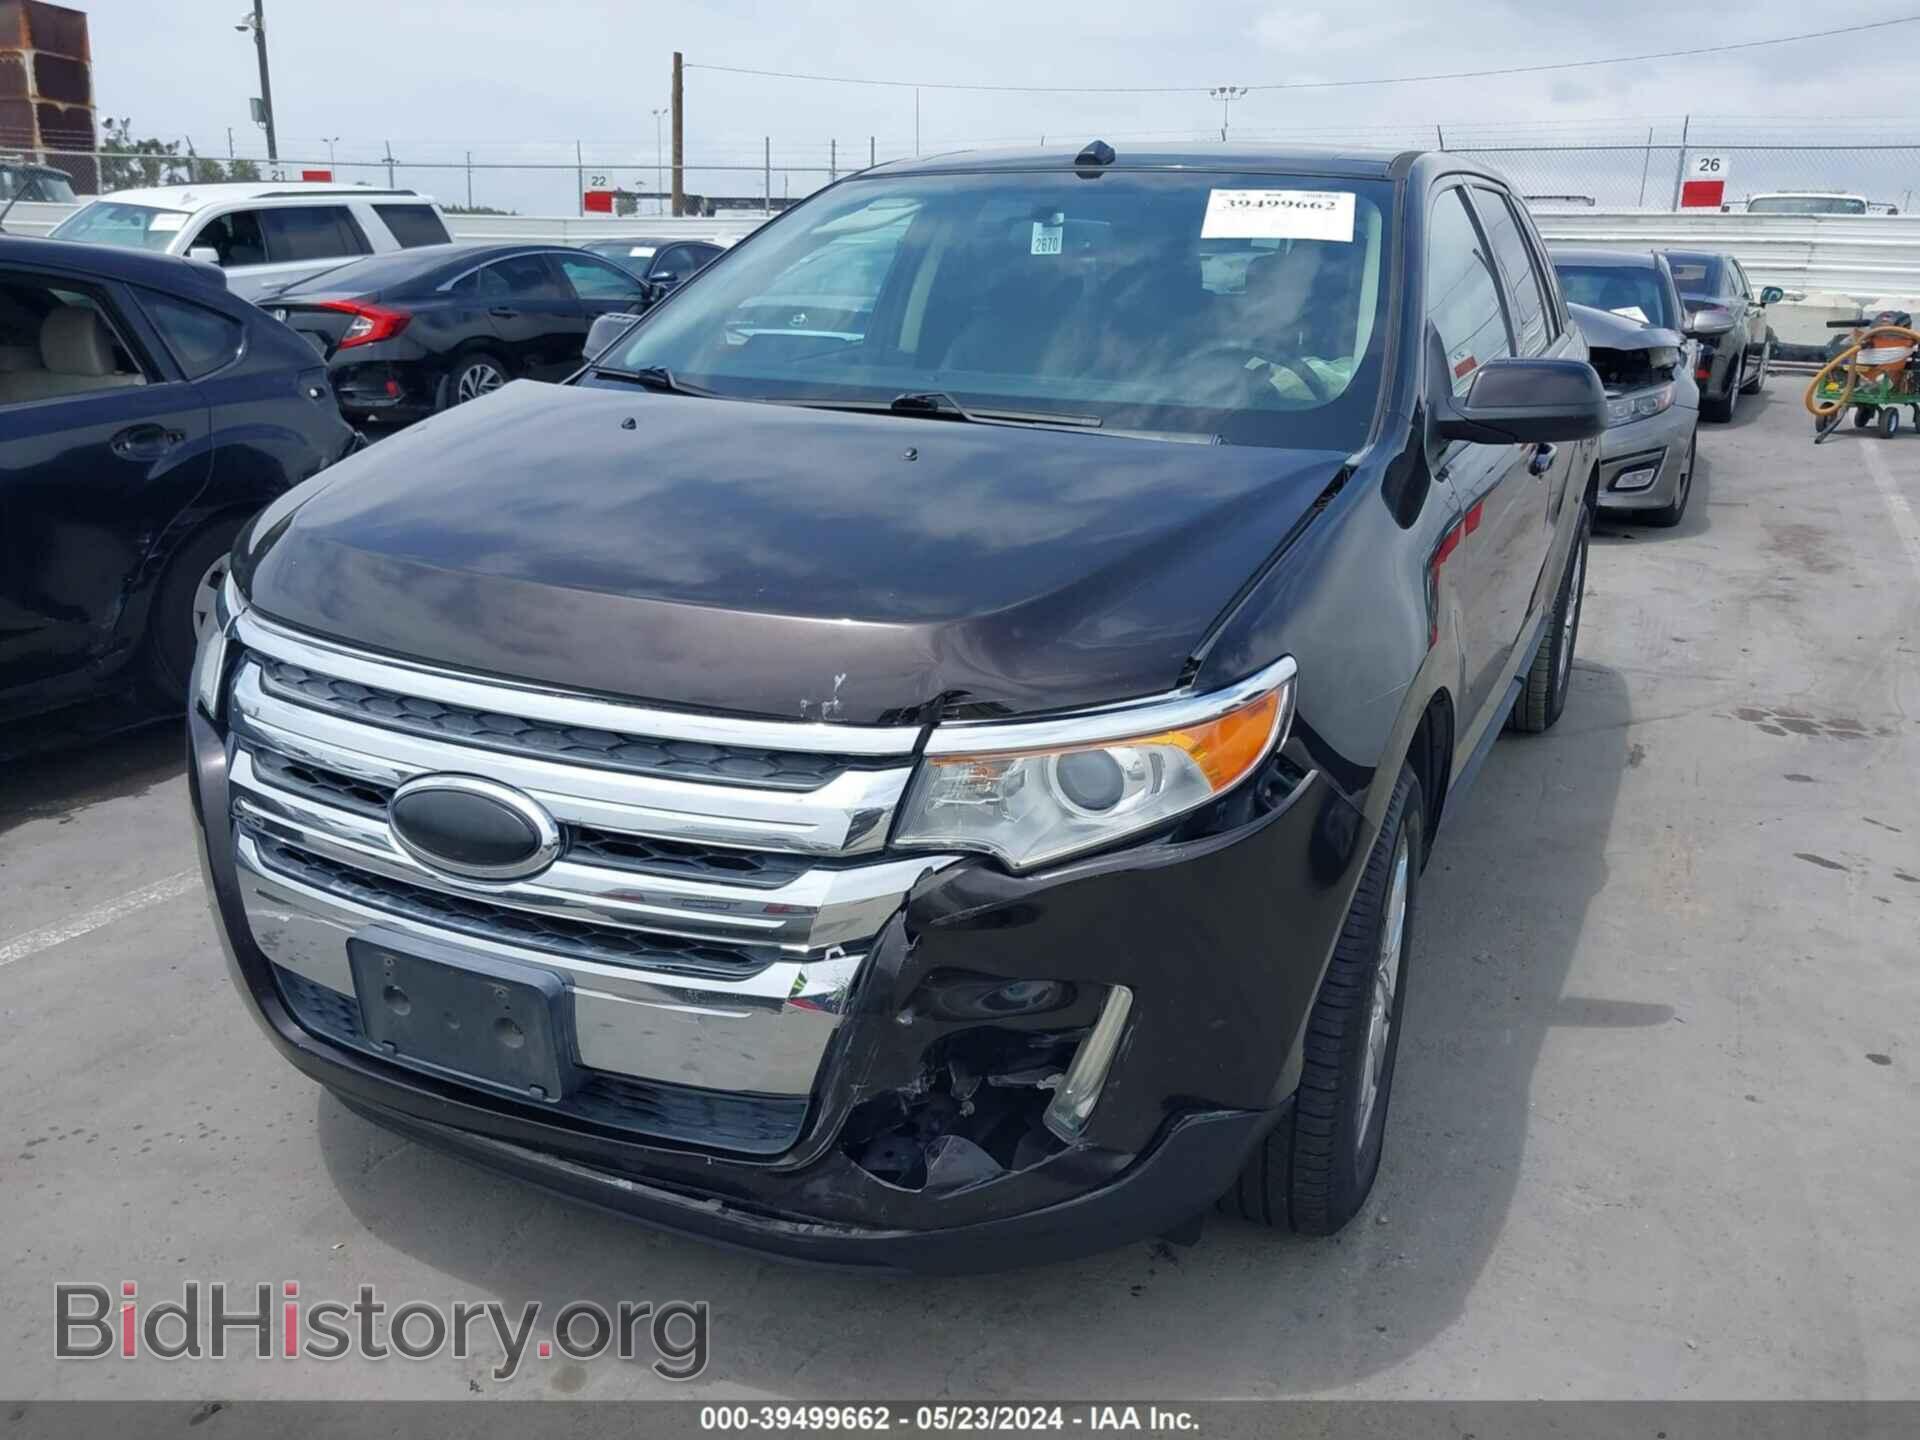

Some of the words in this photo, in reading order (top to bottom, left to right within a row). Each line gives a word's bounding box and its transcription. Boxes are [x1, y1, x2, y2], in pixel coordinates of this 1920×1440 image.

[1699, 158, 1721, 172] 26
[271, 169, 286, 182] 21
[591, 176, 607, 187] 22
[1223, 198, 1337, 211] 39499662
